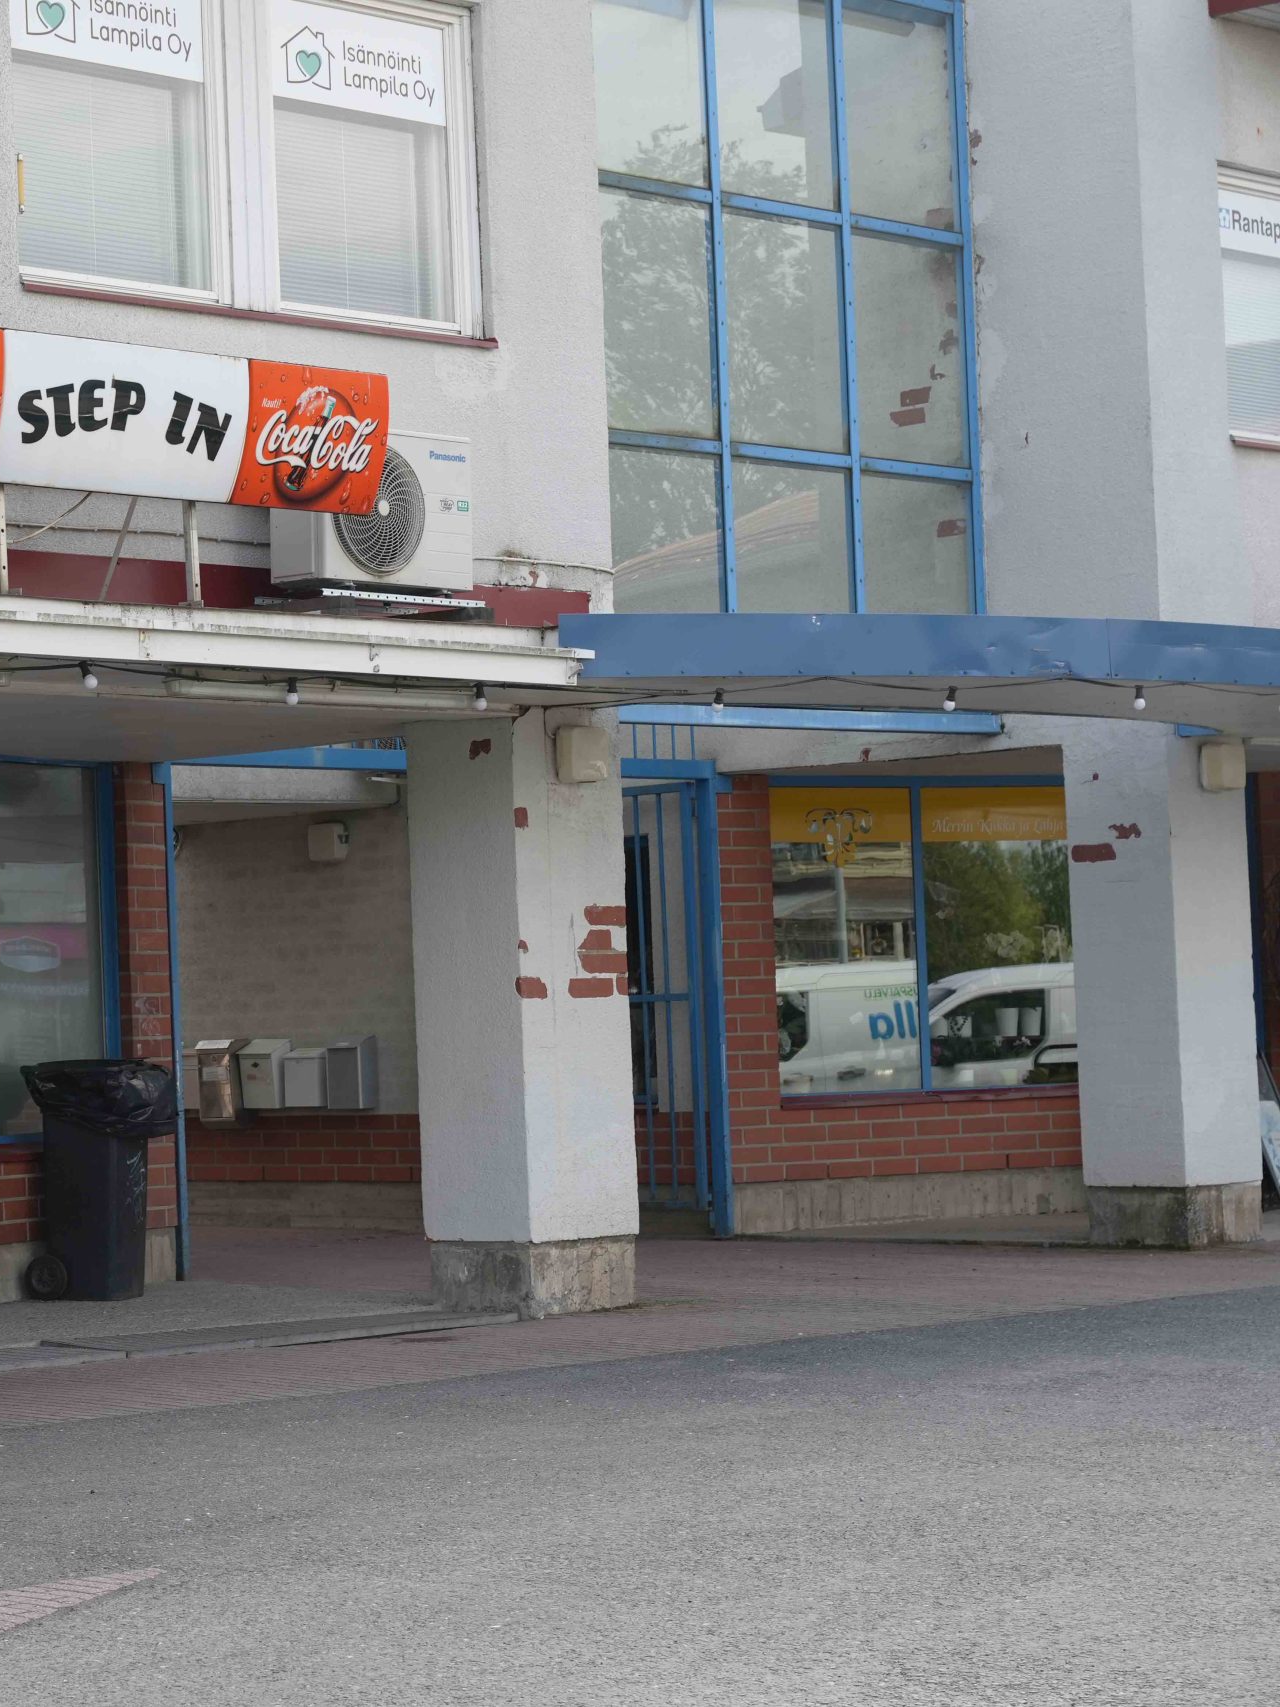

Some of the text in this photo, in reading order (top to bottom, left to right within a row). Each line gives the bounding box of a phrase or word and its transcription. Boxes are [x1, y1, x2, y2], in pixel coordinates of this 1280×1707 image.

[90, 17, 192, 62] Lampila Oy
[342, 40, 422, 75] Isännöinti
[343, 66, 435, 107] Lampila Oy
[17, 378, 233, 462] STEP IN
[261, 397, 283, 409] Nauti!
[255, 409, 379, 473] Coca-Cola
[429, 450, 466, 463] Panasonic
